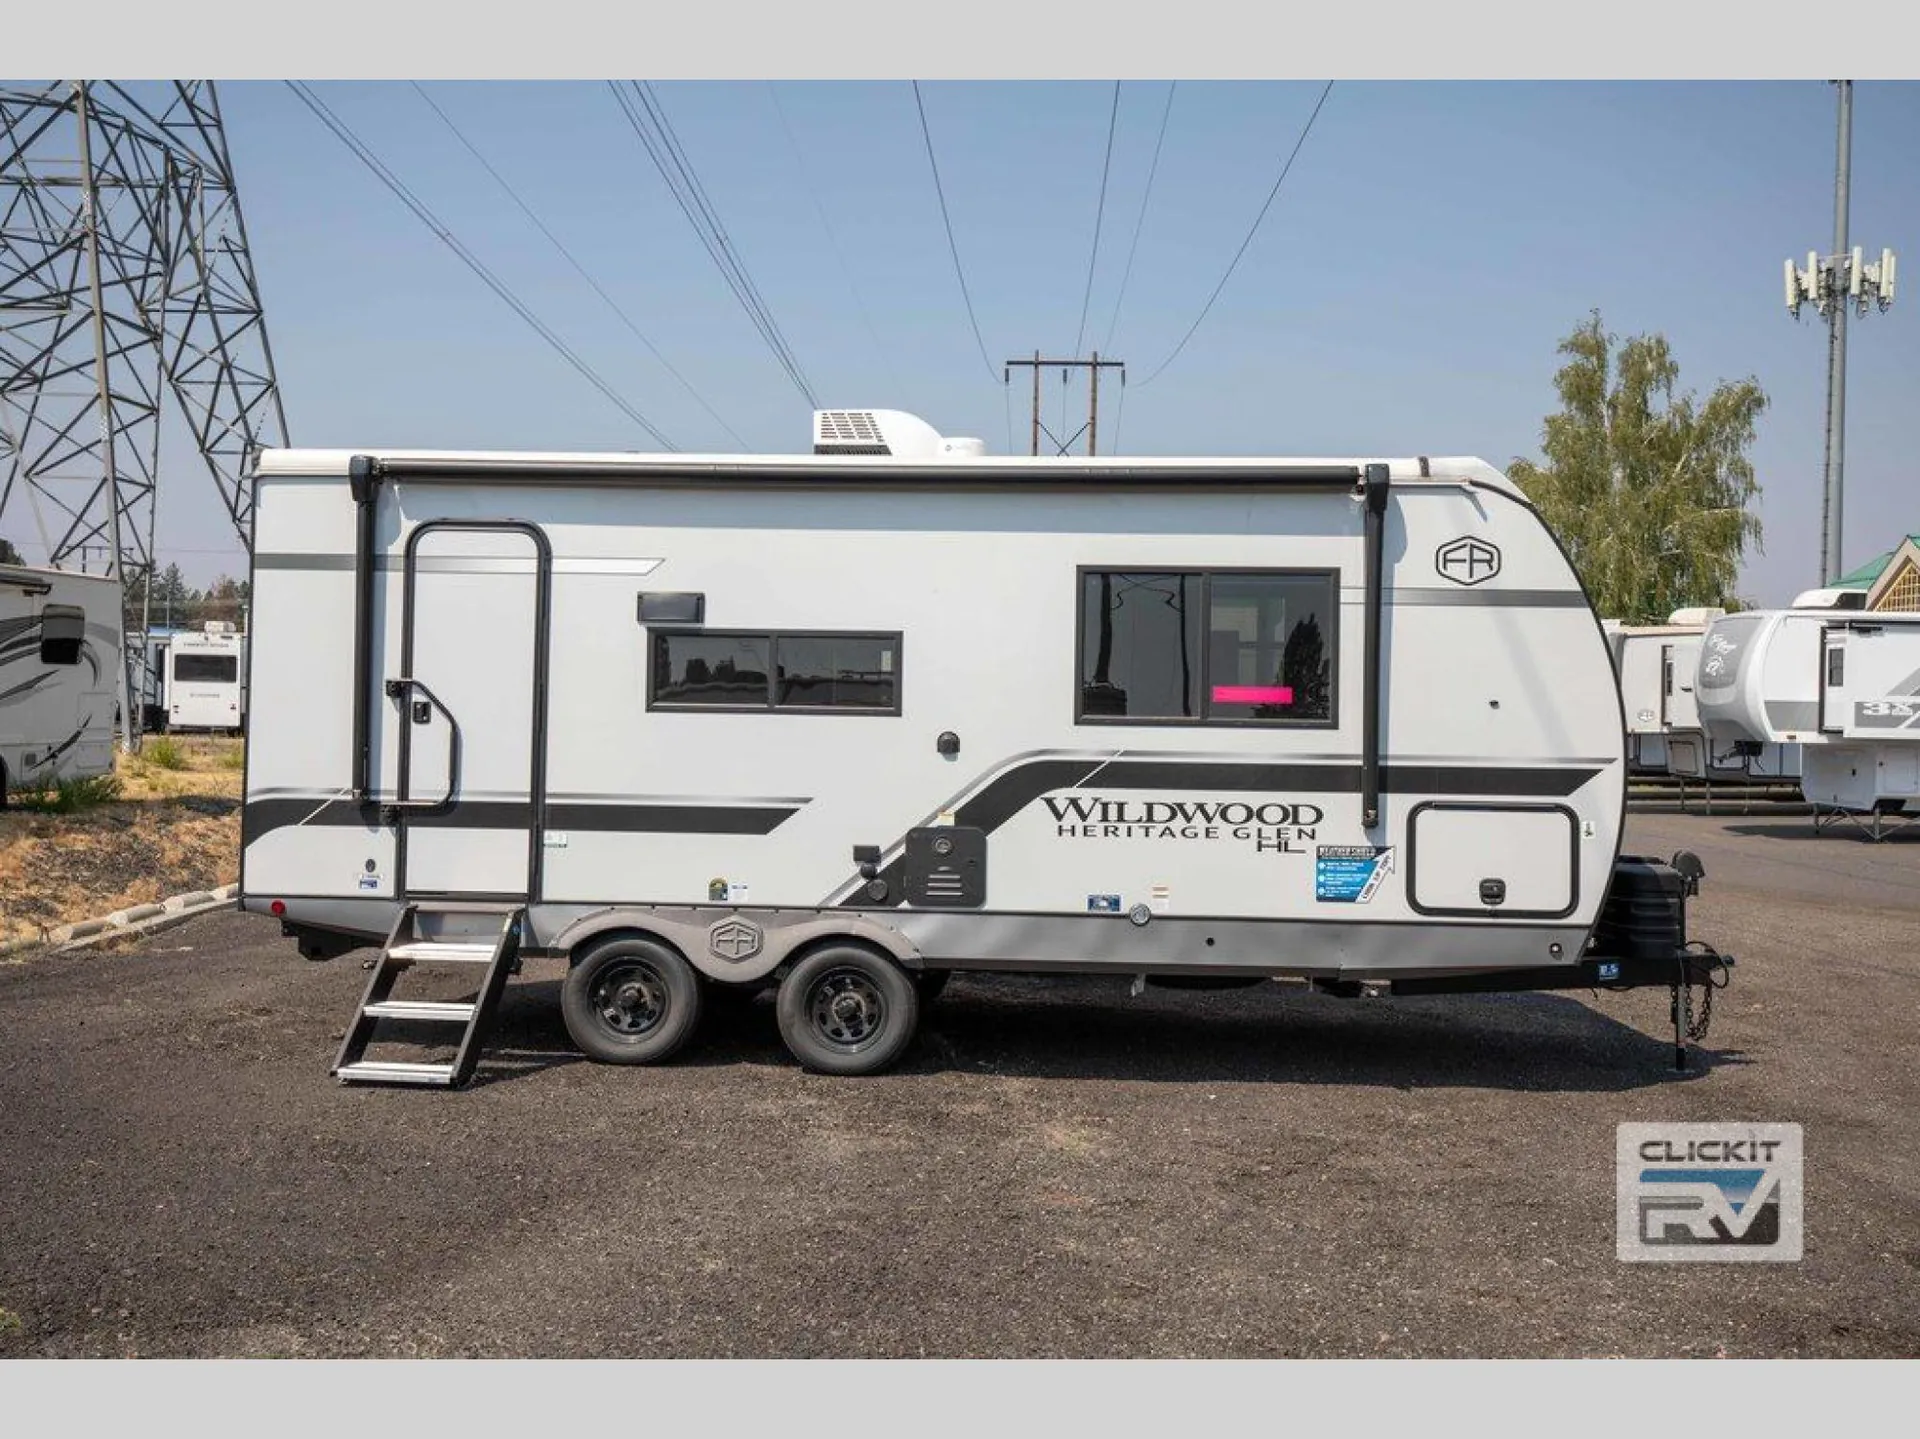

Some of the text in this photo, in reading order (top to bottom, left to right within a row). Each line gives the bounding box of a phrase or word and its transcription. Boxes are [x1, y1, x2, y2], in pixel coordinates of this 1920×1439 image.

[1040, 796, 1325, 826] WILDWOOD
[1057, 825, 1317, 840] HERITAGE GLEN
[1256, 840, 1307, 854] HL
